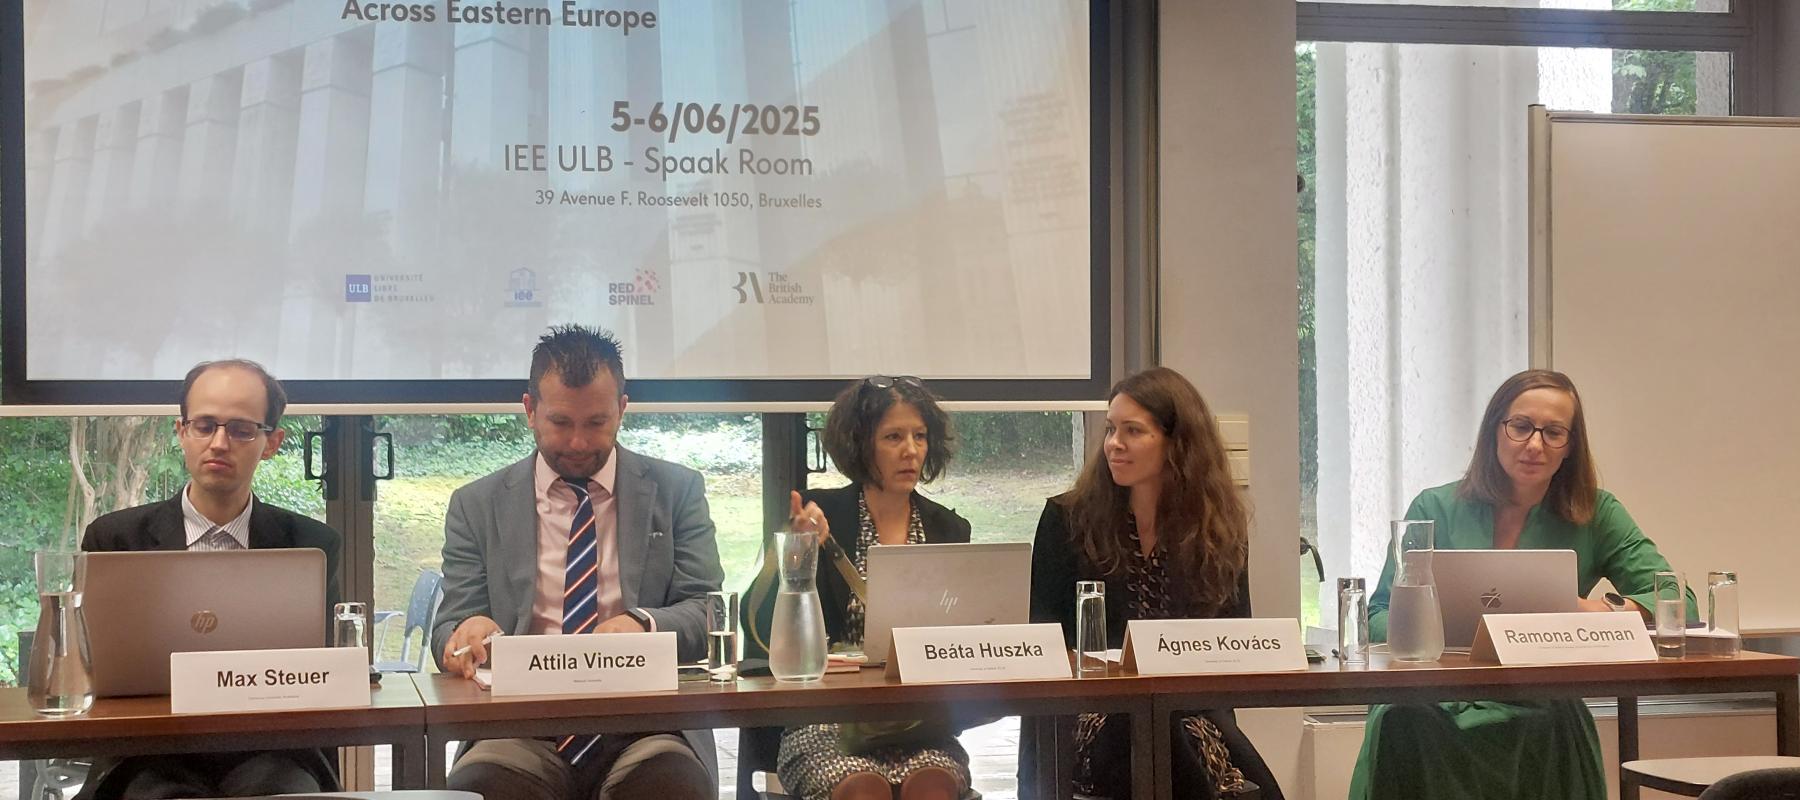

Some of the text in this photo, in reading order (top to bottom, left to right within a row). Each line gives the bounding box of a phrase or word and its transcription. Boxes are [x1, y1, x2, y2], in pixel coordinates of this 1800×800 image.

[341, 0, 657, 35] Across Eastern Europe
[610, 100, 821, 144] 5-6/06/2025
[504, 144, 546, 172] IEE
[558, 145, 614, 173] ULB
[644, 147, 729, 181] Spaak
[739, 148, 813, 176] Room
[535, 189, 823, 211] 39 Avenue F. Roosevelt 1050, Bruxelles
[767, 271, 788, 282] The
[348, 283, 369, 294] ULB
[608, 282, 635, 294] RED
[768, 282, 802, 293] British
[608, 294, 655, 306] SPINEL
[768, 293, 816, 306] Academy
[194, 610, 216, 635] hp
[1158, 633, 1281, 656] Ágnes Kovács
[1504, 628, 1635, 644] Ramona Coman
[924, 642, 1044, 660] Beáta Huszka
[528, 652, 646, 671] Attila Vincze
[217, 668, 330, 688] Max Steuer
